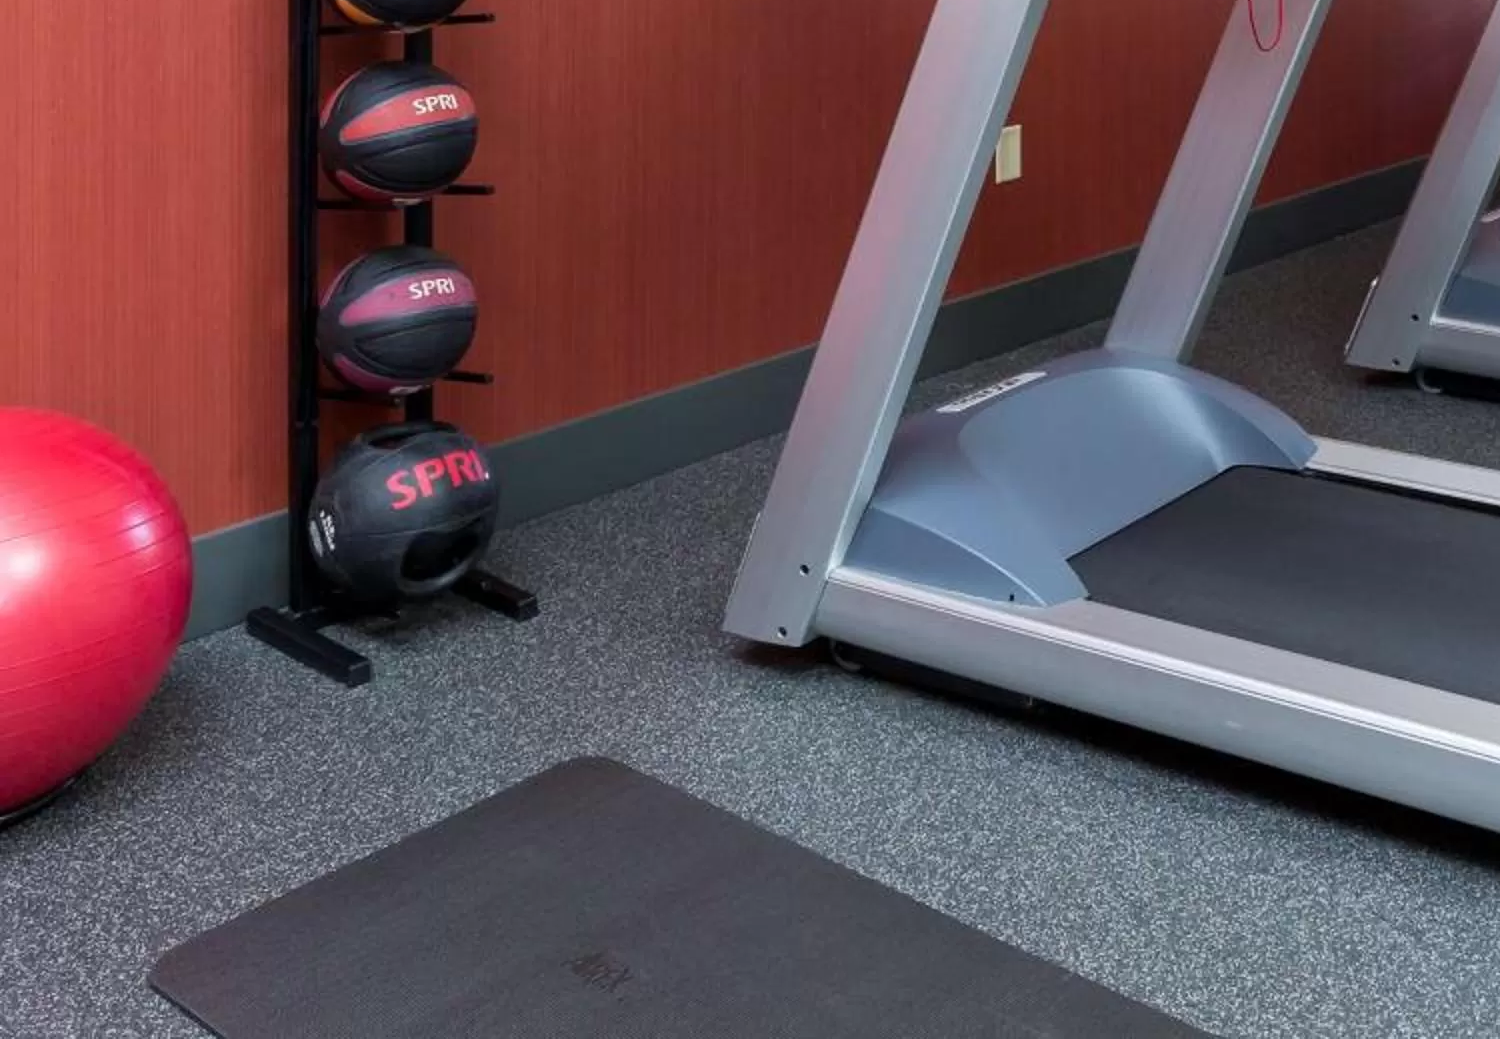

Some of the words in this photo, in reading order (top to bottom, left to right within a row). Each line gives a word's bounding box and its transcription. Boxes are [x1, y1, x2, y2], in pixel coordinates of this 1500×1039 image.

[412, 93, 457, 115] SPRI
[408, 276, 455, 300] SPRI
[386, 449, 485, 509] SPRI
